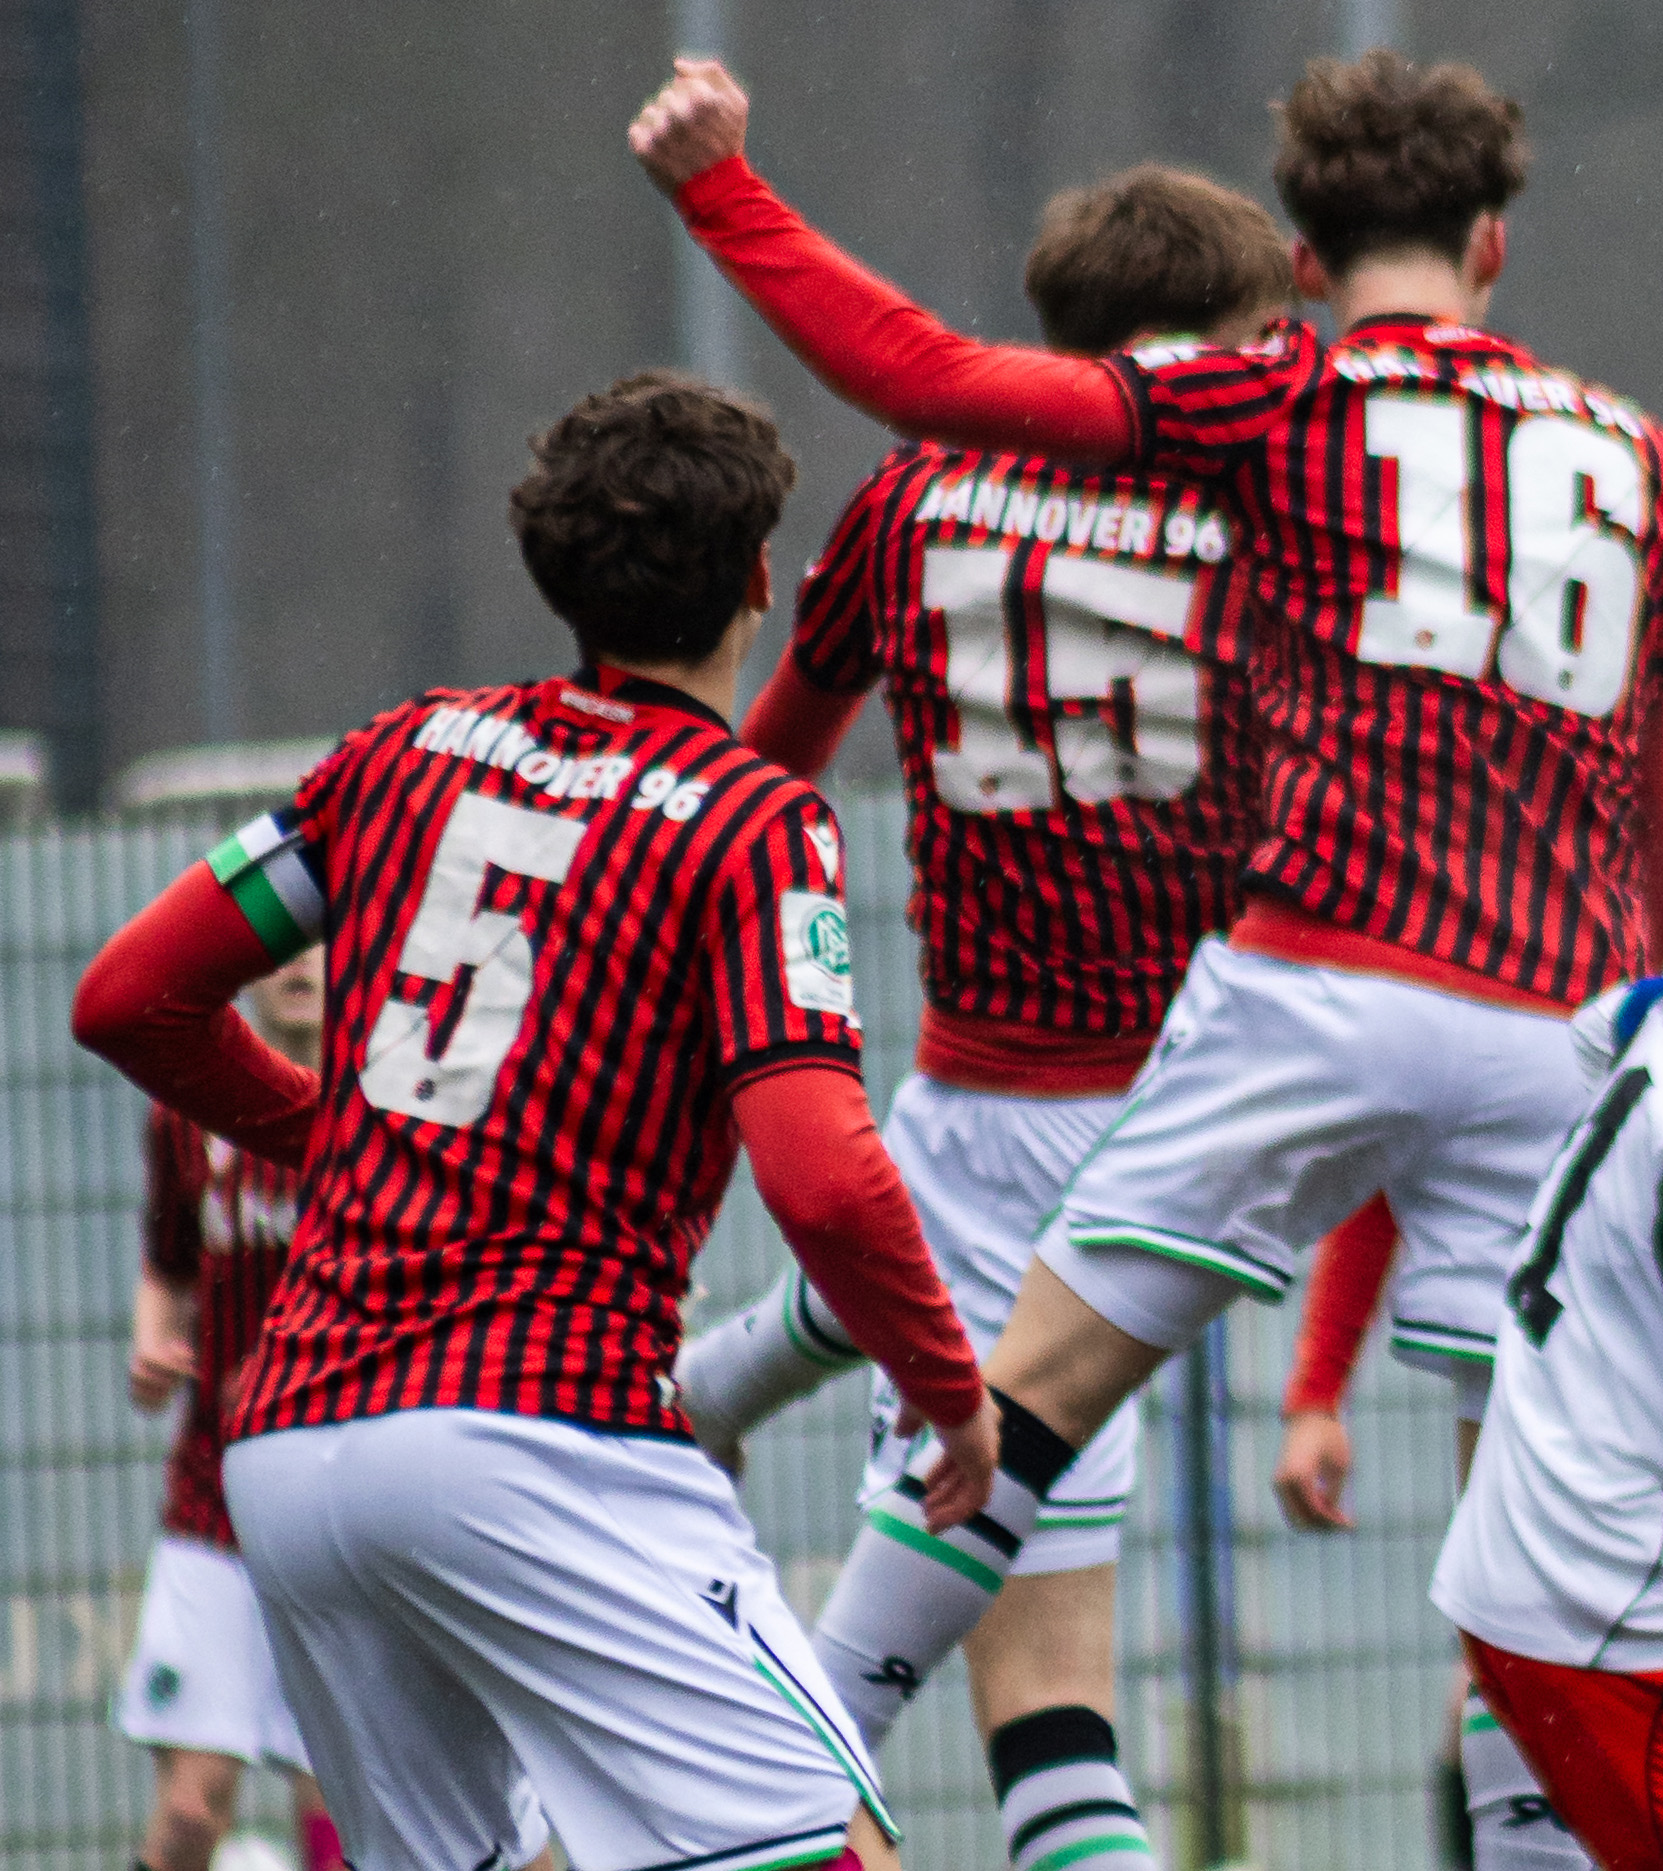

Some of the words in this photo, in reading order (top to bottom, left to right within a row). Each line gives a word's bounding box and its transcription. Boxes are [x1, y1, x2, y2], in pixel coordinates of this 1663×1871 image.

[1164, 511, 1229, 563] 96
[1356, 390, 1648, 719] 16
[631, 766, 711, 823] 96
[922, 546, 1202, 815] 15
[359, 790, 589, 1128] 5
